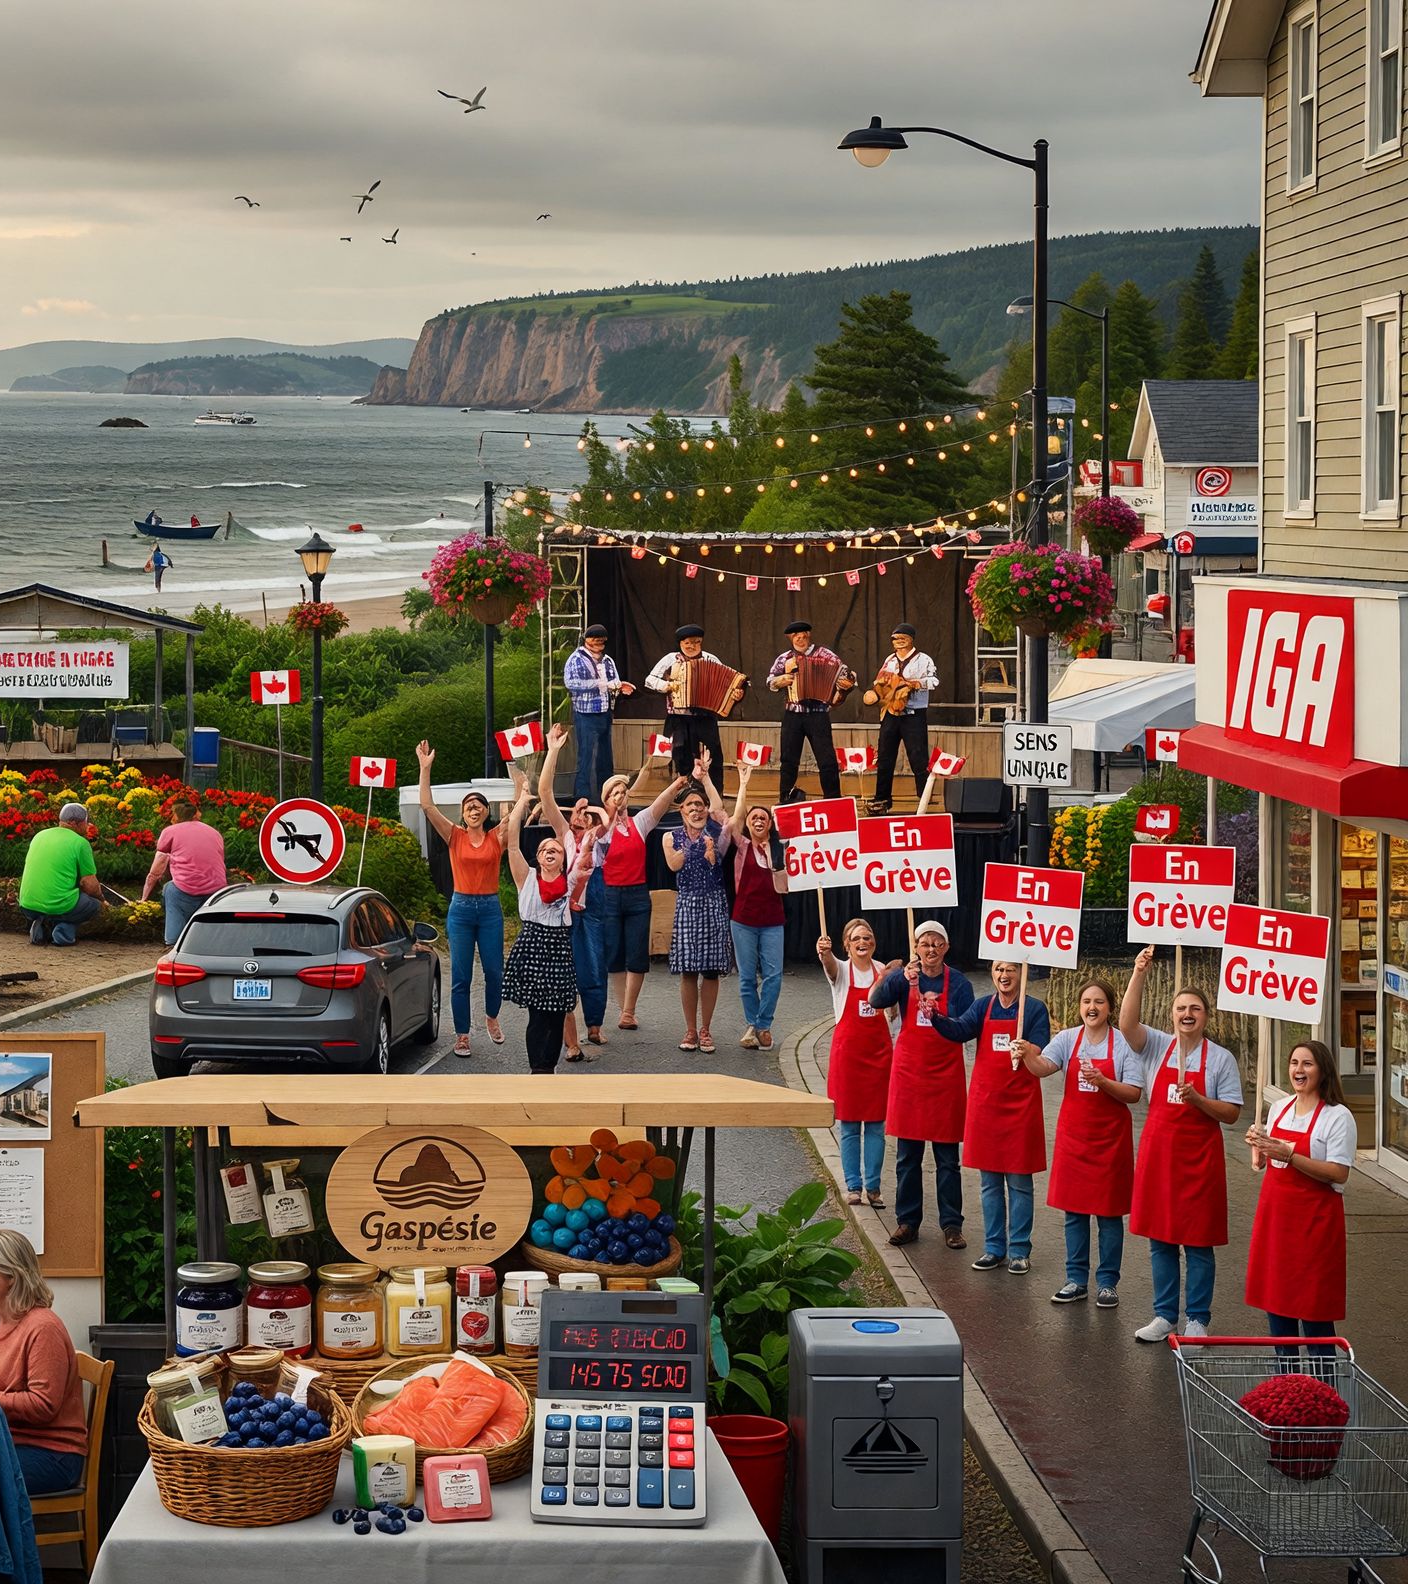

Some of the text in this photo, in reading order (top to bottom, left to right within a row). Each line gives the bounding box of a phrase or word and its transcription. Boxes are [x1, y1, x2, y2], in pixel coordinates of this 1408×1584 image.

[1229, 607, 1345, 748] IGA
[1013, 732, 1058, 751] SENS
[799, 807, 829, 833] En
[889, 821, 922, 848] En
[864, 858, 952, 894] Grève
[1166, 851, 1200, 880] En
[1016, 871, 1050, 902] En
[1133, 892, 1226, 931] Grève
[985, 909, 1074, 951] Grève
[1257, 914, 1293, 949] En
[1224, 956, 1318, 1006] Grève
[359, 1210, 497, 1252] Gaspésie
[570, 1362, 600, 1387] 145
[608, 1363, 633, 1388] 75
